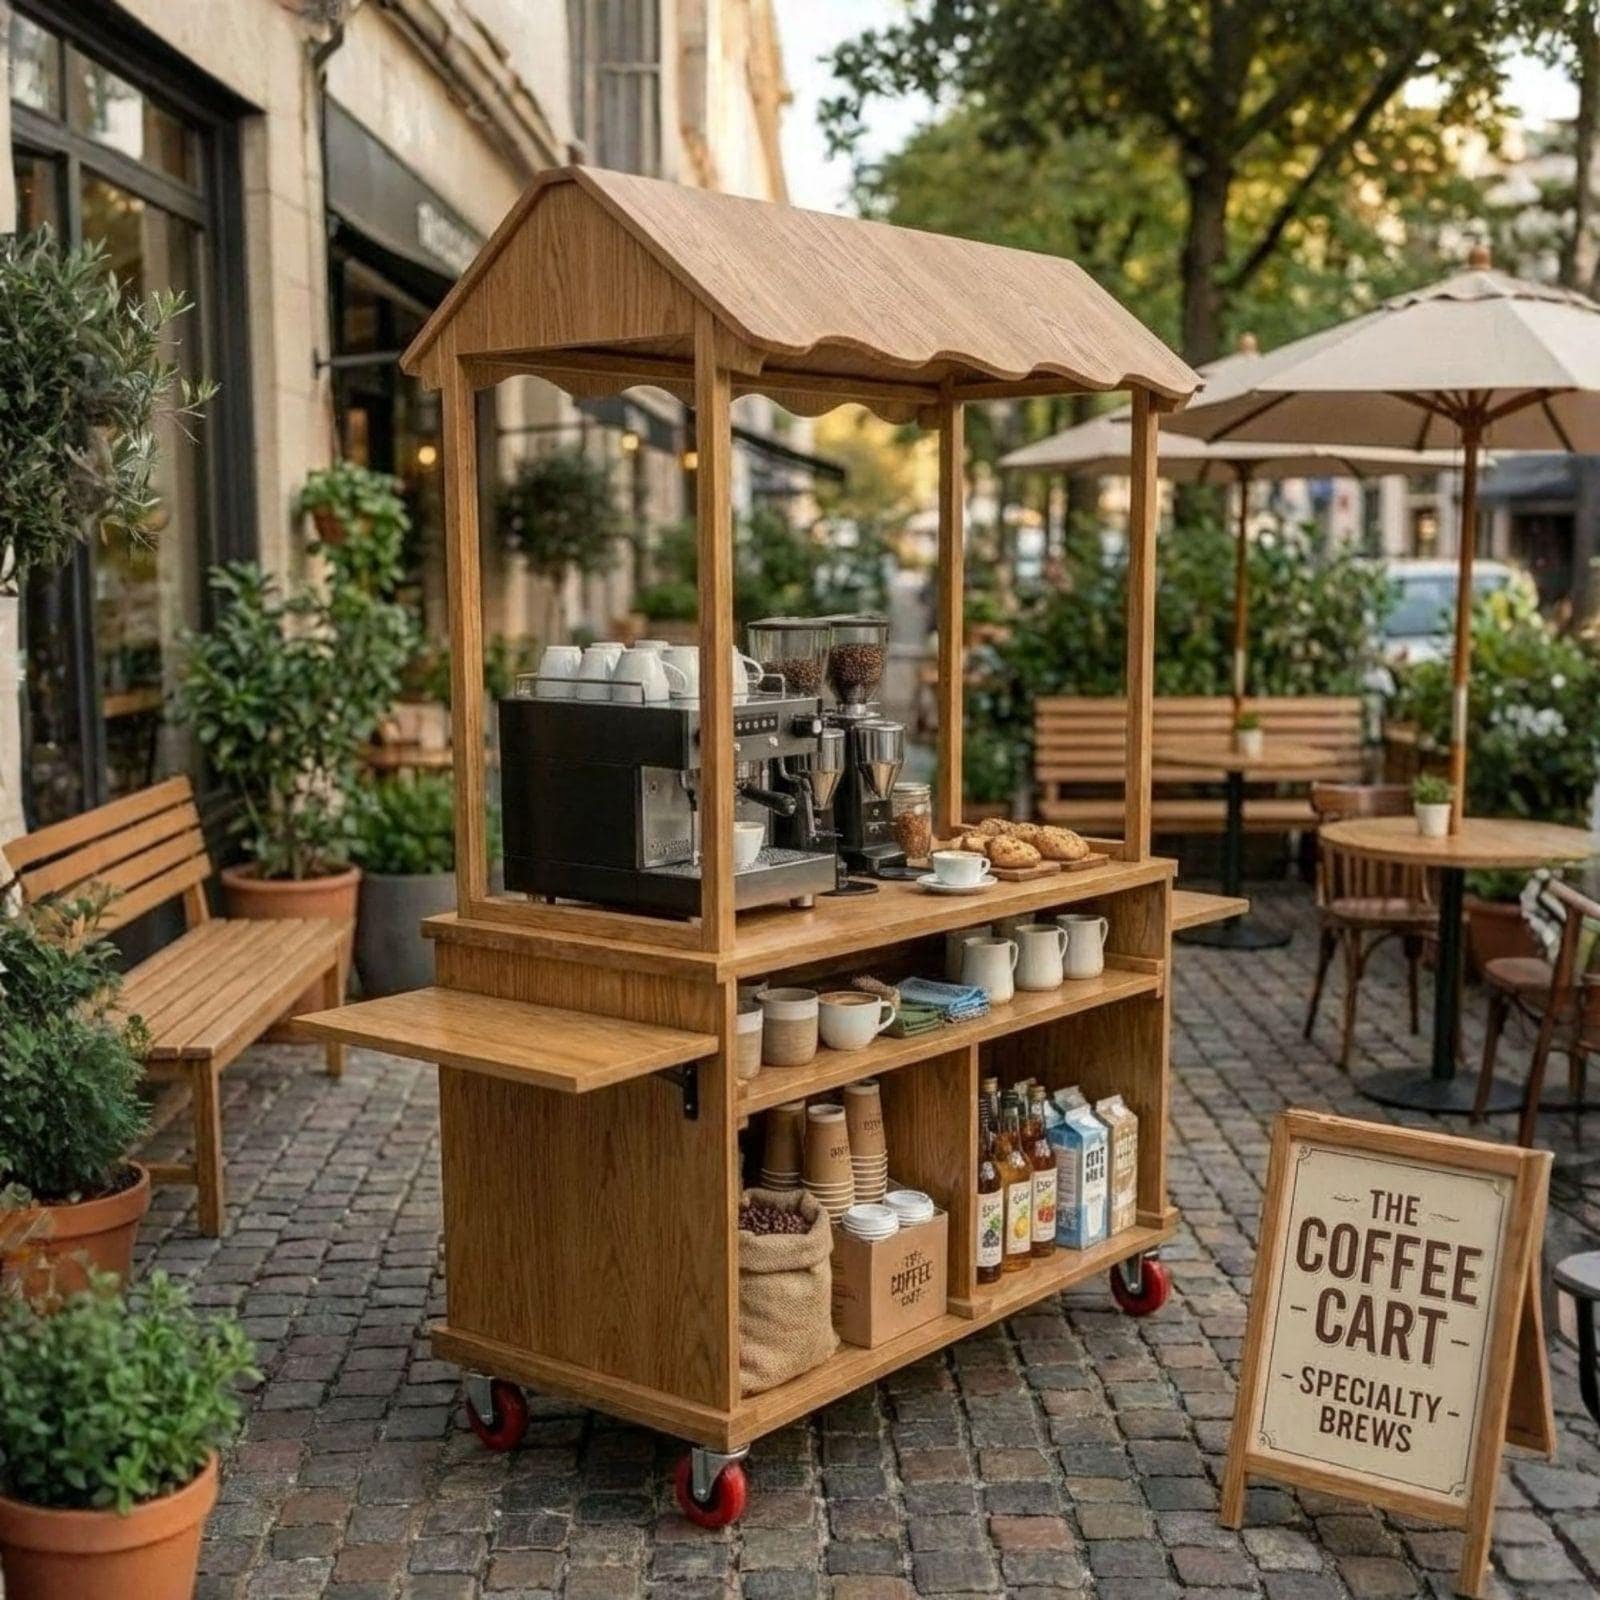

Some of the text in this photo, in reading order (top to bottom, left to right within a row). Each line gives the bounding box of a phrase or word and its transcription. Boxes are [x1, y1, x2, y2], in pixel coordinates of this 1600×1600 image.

[1370, 1189, 1421, 1227] THE
[1296, 1216, 1483, 1307] COFFEE
[1315, 1287, 1448, 1365] CART
[1299, 1365, 1443, 1424] SPECIALTY
[1318, 1404, 1413, 1453] BREWS
